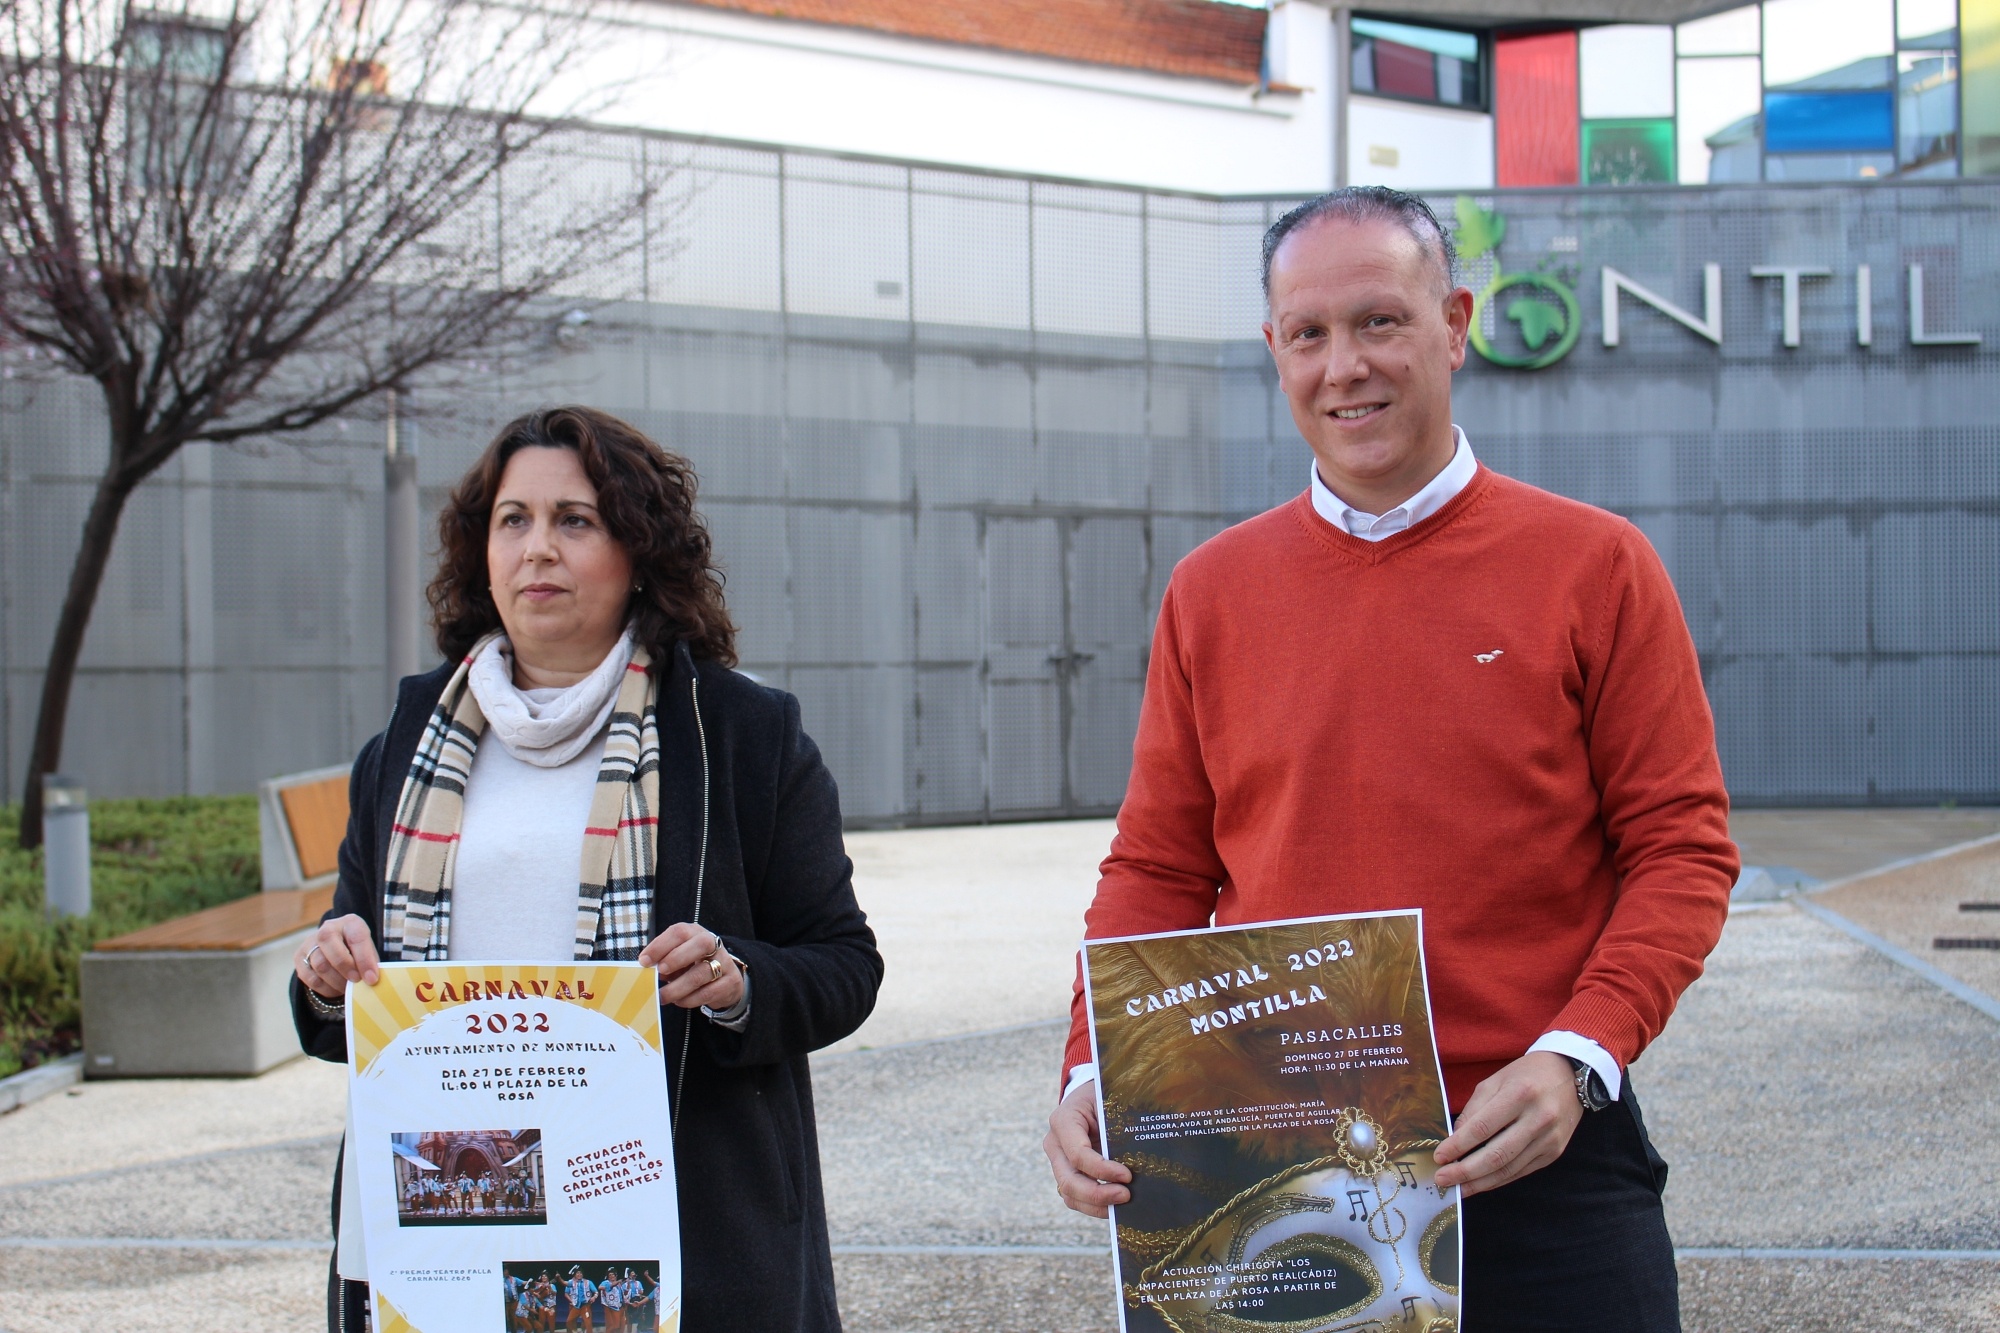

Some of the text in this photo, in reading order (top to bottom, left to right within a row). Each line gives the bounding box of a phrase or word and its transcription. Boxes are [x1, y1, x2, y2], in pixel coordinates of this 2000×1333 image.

[1126, 939, 1354, 1017] CARNAVAL 2022
[415, 979, 595, 1003] CARNAVAL
[1189, 984, 1327, 1036] MONTILLA
[465, 1012, 550, 1035] 2022
[1280, 1024, 1403, 1045] PASACALLES
[405, 1042, 617, 1057] AYUNTAMIENTO DE MONTILLA
[1285, 1046, 1403, 1063] DOMINGO 27 DE FEBRERO
[442, 1066, 586, 1079] DIA 27 DE FEBRERO
[1280, 1057, 1410, 1075] HORA: 11:30 DE LA MAÑANA
[483, 1080, 492, 1090] H
[497, 1079, 542, 1089] PLAZA
[547, 1078, 566, 1088] DE
[571, 1078, 588, 1088] LA
[497, 1091, 535, 1101] ROSA
[1140, 1112, 1188, 1122] RECORRIDO:
[1190, 1109, 1212, 1118] AVDA
[1213, 1108, 1224, 1116] DE
[1300, 1099, 1325, 1109] MARÍA
[1264, 1112, 1294, 1120] PUERTA
[1295, 1110, 1305, 1118] DE
[1184, 1126, 1237, 1137] FINALIZANDO
[1239, 1124, 1249, 1132] EN
[1251, 1123, 1261, 1131] LA
[1263, 1121, 1288, 1130] PLAZA
[1290, 1120, 1300, 1128] DE
[1302, 1119, 1312, 1127] LA
[1314, 1117, 1335, 1126] ROSA
[567, 1138, 643, 1168] ACTUACIÓN
[571, 1151, 646, 1178] CHIRIGOTA
[562, 1167, 631, 1193] GADITANA
[1162, 1258, 1311, 1277] ACTUACIÓN CHIRIGOTA "LOS
[1139, 1278, 1211, 1291] IMPACIENTES"
[1214, 1276, 1227, 1285] DE
[1230, 1273, 1269, 1284] PUERTO
[1141, 1281, 1337, 1304] EN LA PLAZA DE LA ROSA A PARTIR DE
[1215, 1299, 1264, 1310] LAS 14:00
